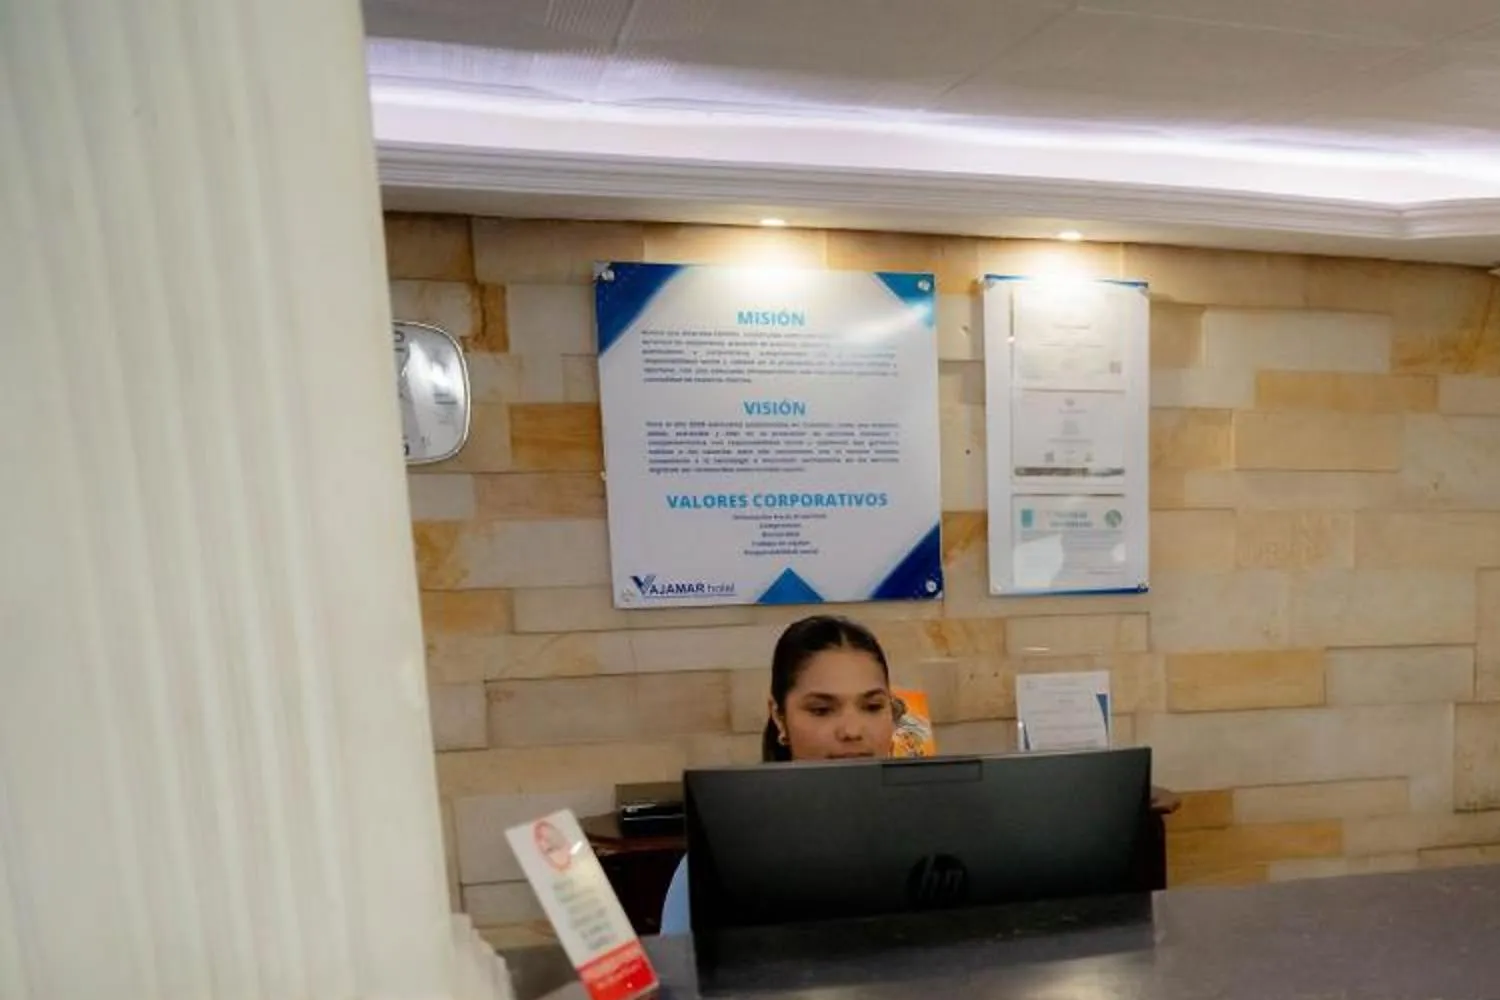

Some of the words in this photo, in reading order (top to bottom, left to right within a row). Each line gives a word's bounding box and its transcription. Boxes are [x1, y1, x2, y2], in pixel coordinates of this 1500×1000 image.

[737, 310, 805, 326] MISIÓN
[743, 399, 806, 416] VISIÓN
[666, 494, 747, 509] VALORES
[753, 492, 888, 508] CORPORATIVOS
[629, 575, 705, 595] VAJAMAR
